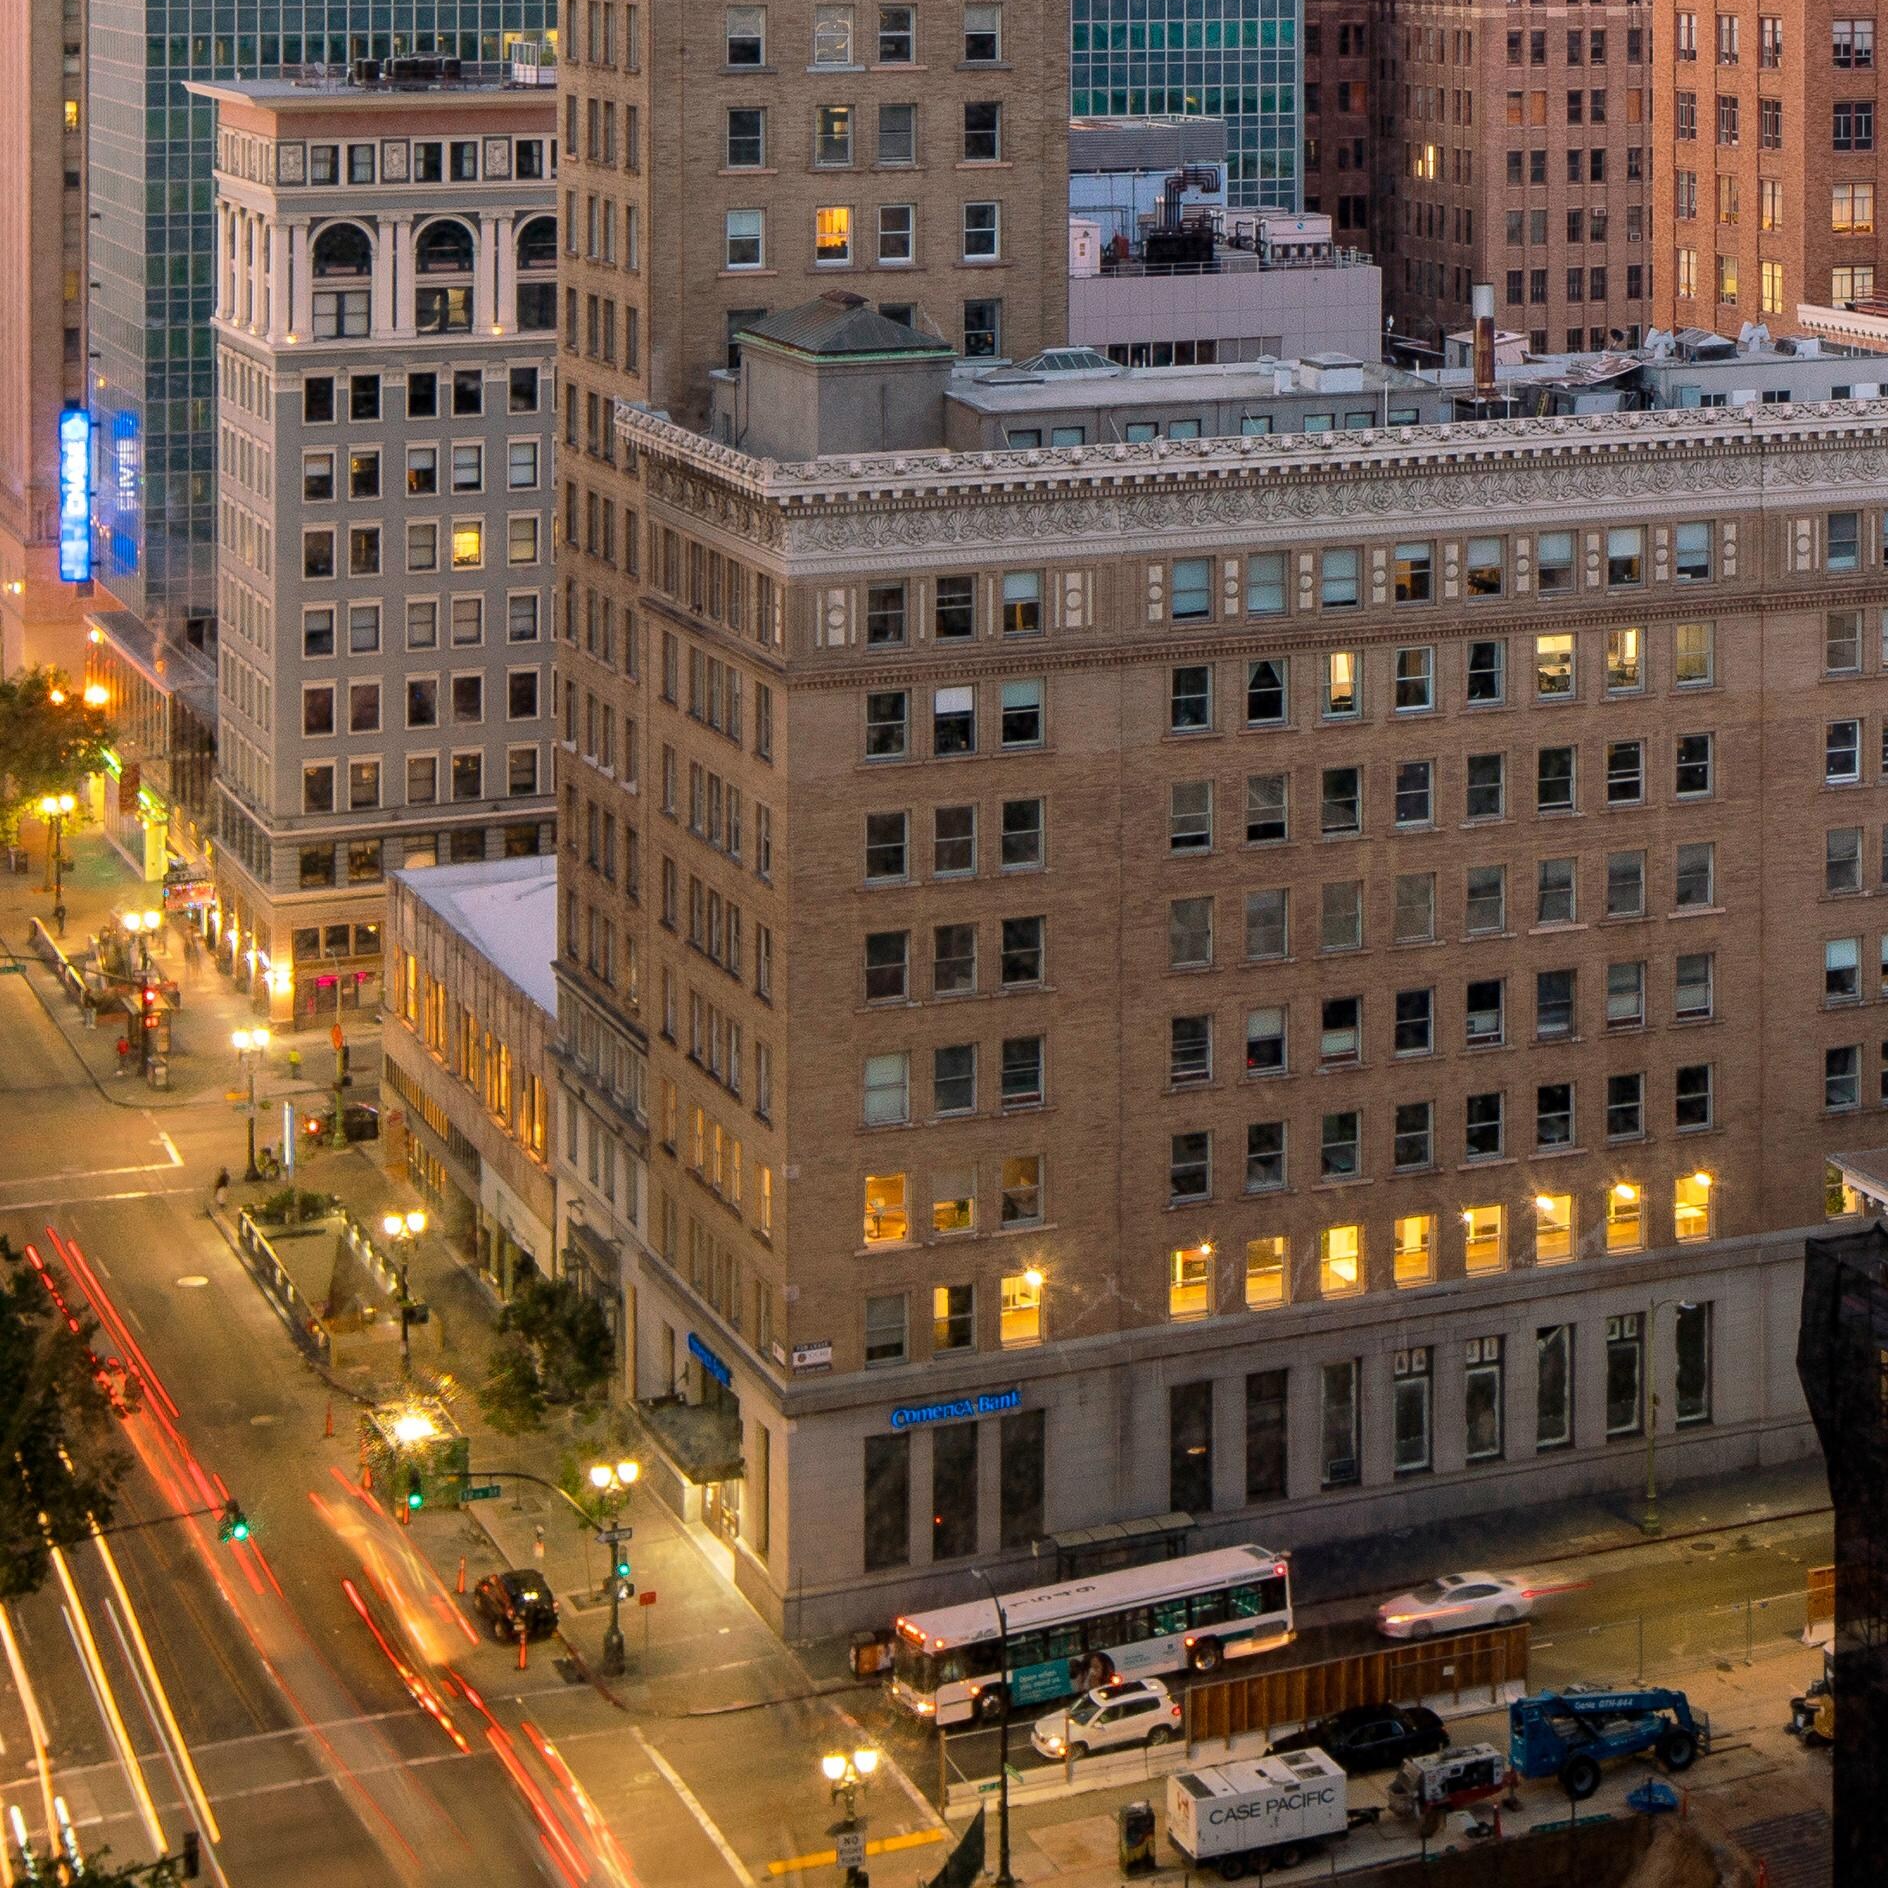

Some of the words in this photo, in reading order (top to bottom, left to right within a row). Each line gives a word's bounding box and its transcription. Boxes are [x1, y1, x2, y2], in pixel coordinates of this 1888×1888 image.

[978, 1390, 1022, 1412] Bank
[1209, 1802, 1261, 1825] CASE
[1266, 1788, 1335, 1814] PACIFIC
